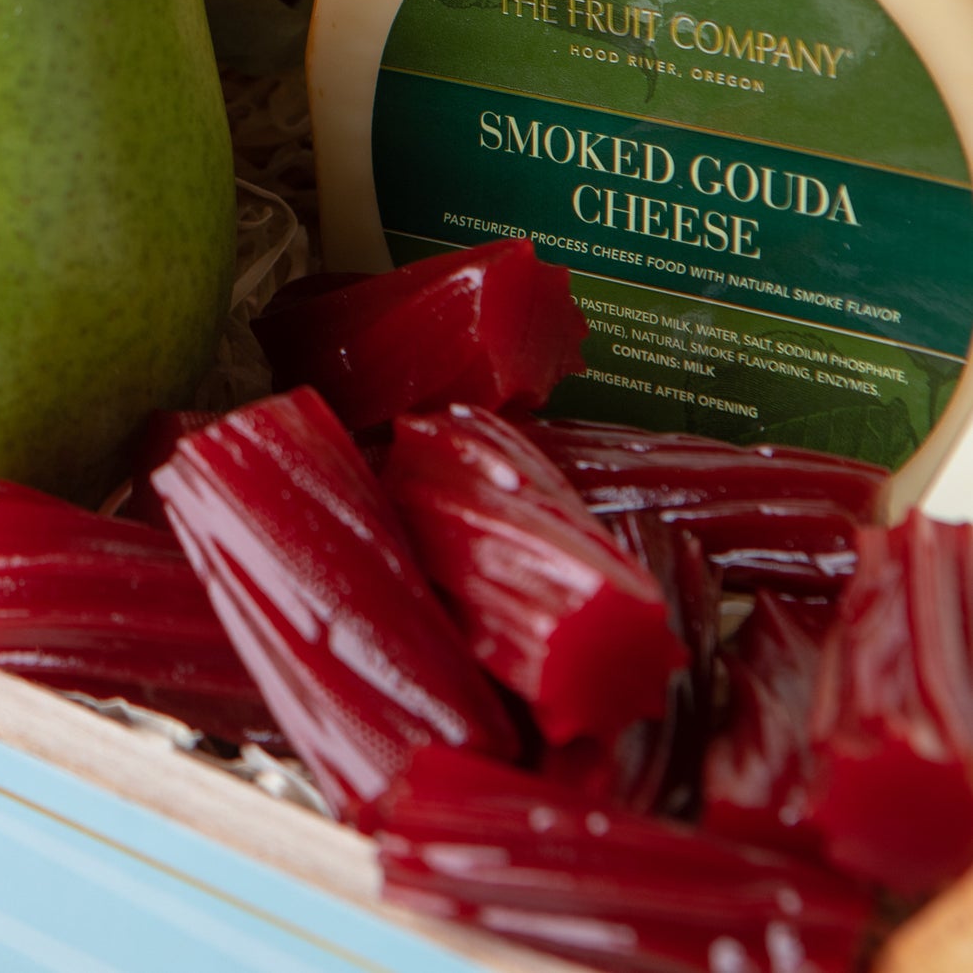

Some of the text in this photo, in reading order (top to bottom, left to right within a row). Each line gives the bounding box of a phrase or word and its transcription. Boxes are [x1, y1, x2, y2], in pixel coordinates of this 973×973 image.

[570, 44, 765, 93] HOOD RIVER, OREGON
[480, 110, 862, 227] SMOKED GOUDA
[572, 184, 761, 260] CHEESE
[443, 212, 902, 324] PASTEURIZED PROCESS CHEESE FOOD WITH NATURAL SMOKE FLAVOR
[580, 297, 659, 325] PASTEURIZED
[661, 316, 694, 334] MILK,
[696, 323, 741, 346] WATER,
[777, 341, 828, 365] SODIUM
[830, 353, 909, 385] PHOSPHATE,
[612, 344, 716, 378] CONTAINS: MILK
[631, 329, 688, 352] NATURAL
[690, 342, 736, 363] SMOKE
[570, 368, 759, 420] FRIGERATE AFTER OPENING
